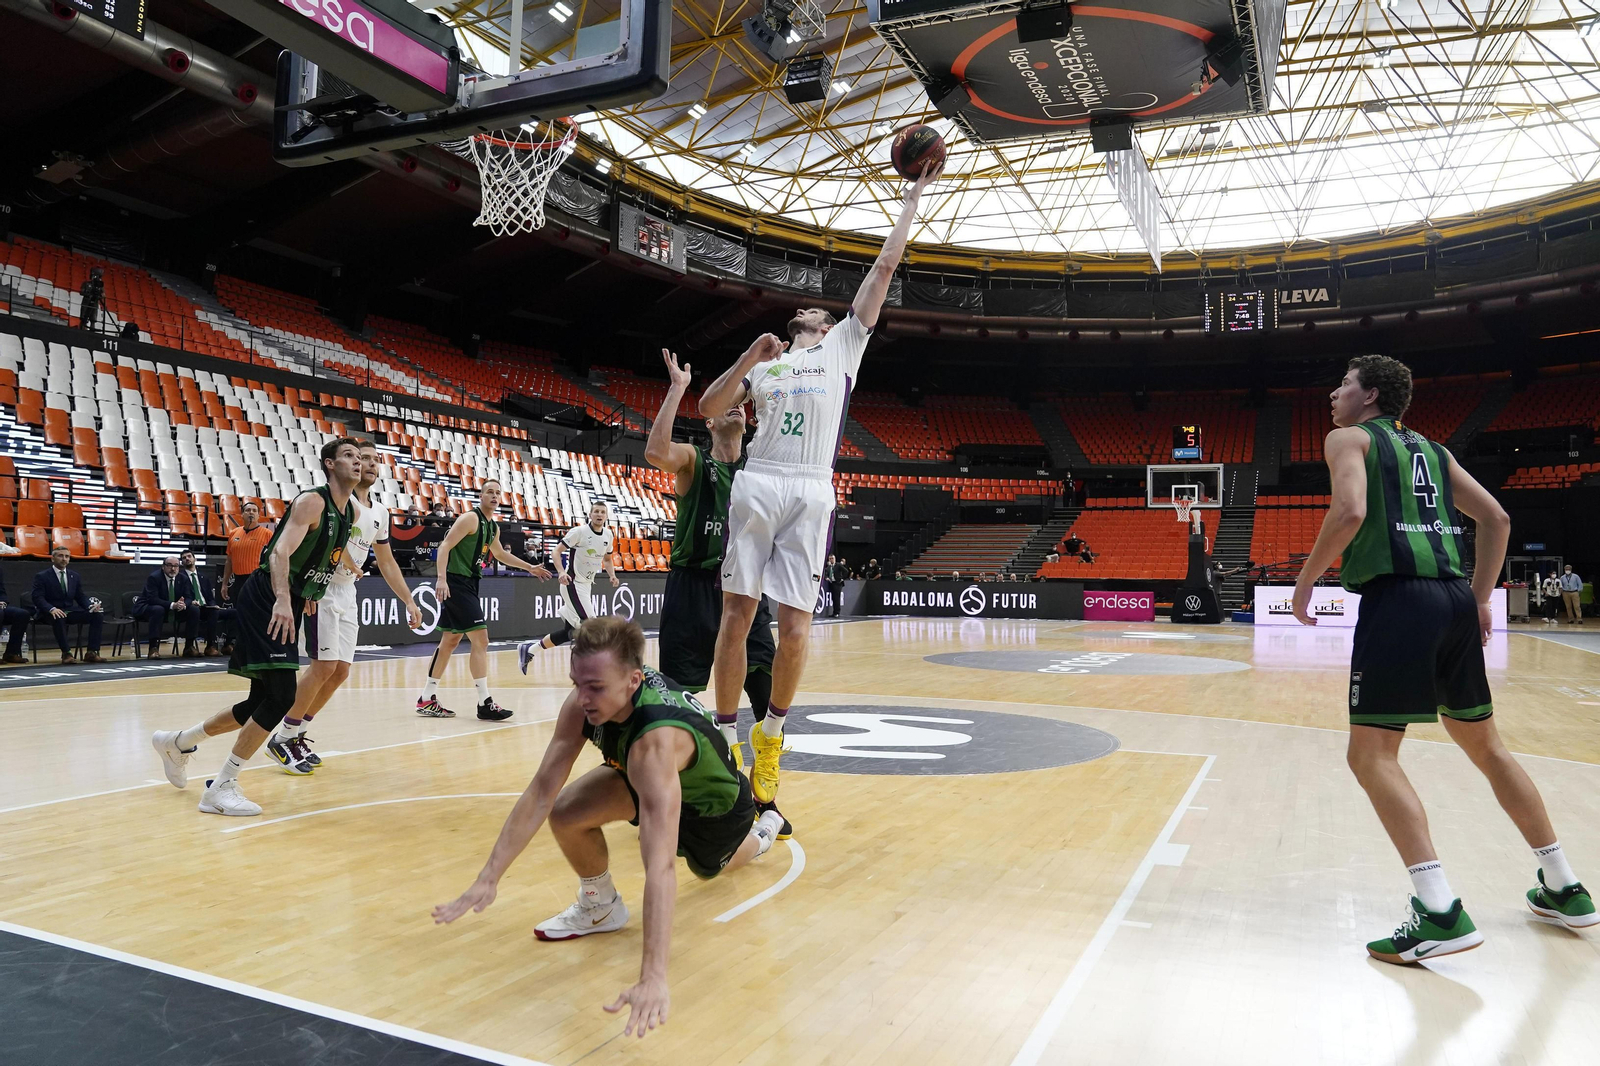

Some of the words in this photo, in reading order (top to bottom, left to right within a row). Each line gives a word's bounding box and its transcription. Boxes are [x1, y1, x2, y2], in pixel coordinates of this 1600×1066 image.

[278, 0, 375, 54] esa
[1050, 33, 1102, 107] XCEPCIONAL
[1072, 26, 1088, 48] UNA
[1082, 52, 1099, 73] FASE
[1093, 76, 1110, 97] FINAL
[1058, 85, 1075, 101] 2020
[0, 204, 11, 214] 10
[102, 339, 118, 351] 111
[382, 394, 393, 404] 110
[780, 411, 805, 437] 32
[1187, 434, 1195, 446] 5
[1568, 450, 1580, 458] 103
[1412, 453, 1439, 508] 4
[1395, 522, 1434, 532] BADALONA
[640, 593, 665, 614] FUT
[883, 591, 954, 607] BADALONA
[992, 593, 1037, 609] FUTUR
[1083, 594, 1150, 609] endesa
[361, 597, 399, 626] ONA
